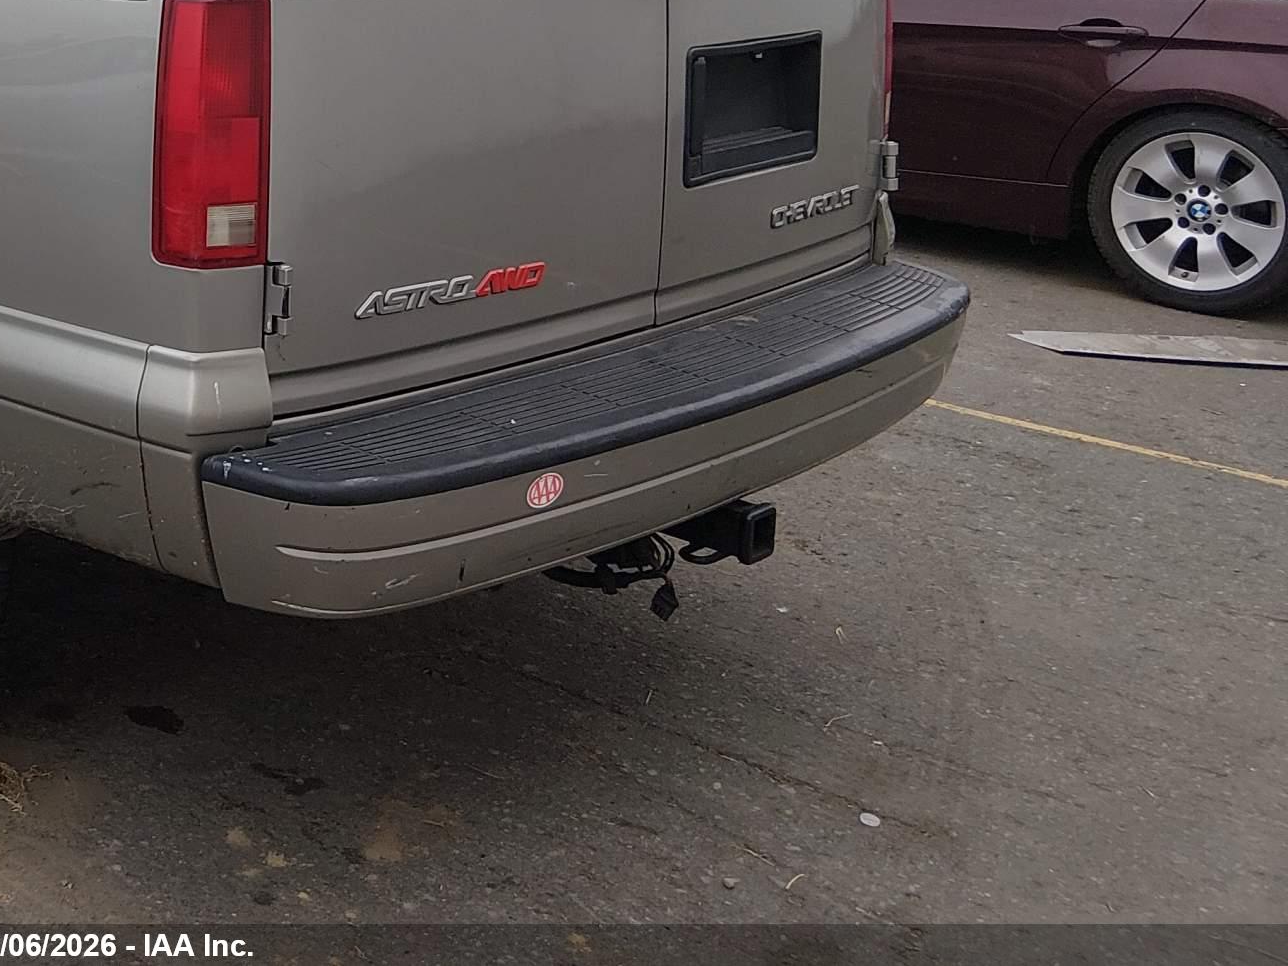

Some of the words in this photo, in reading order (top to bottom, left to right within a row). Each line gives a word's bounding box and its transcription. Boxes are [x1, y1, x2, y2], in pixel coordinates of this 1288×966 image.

[770, 184, 859, 229] CHEVROLET
[354, 274, 475, 320] ASTRO
[475, 261, 545, 297] AWD
[529, 474, 563, 506] AAA
